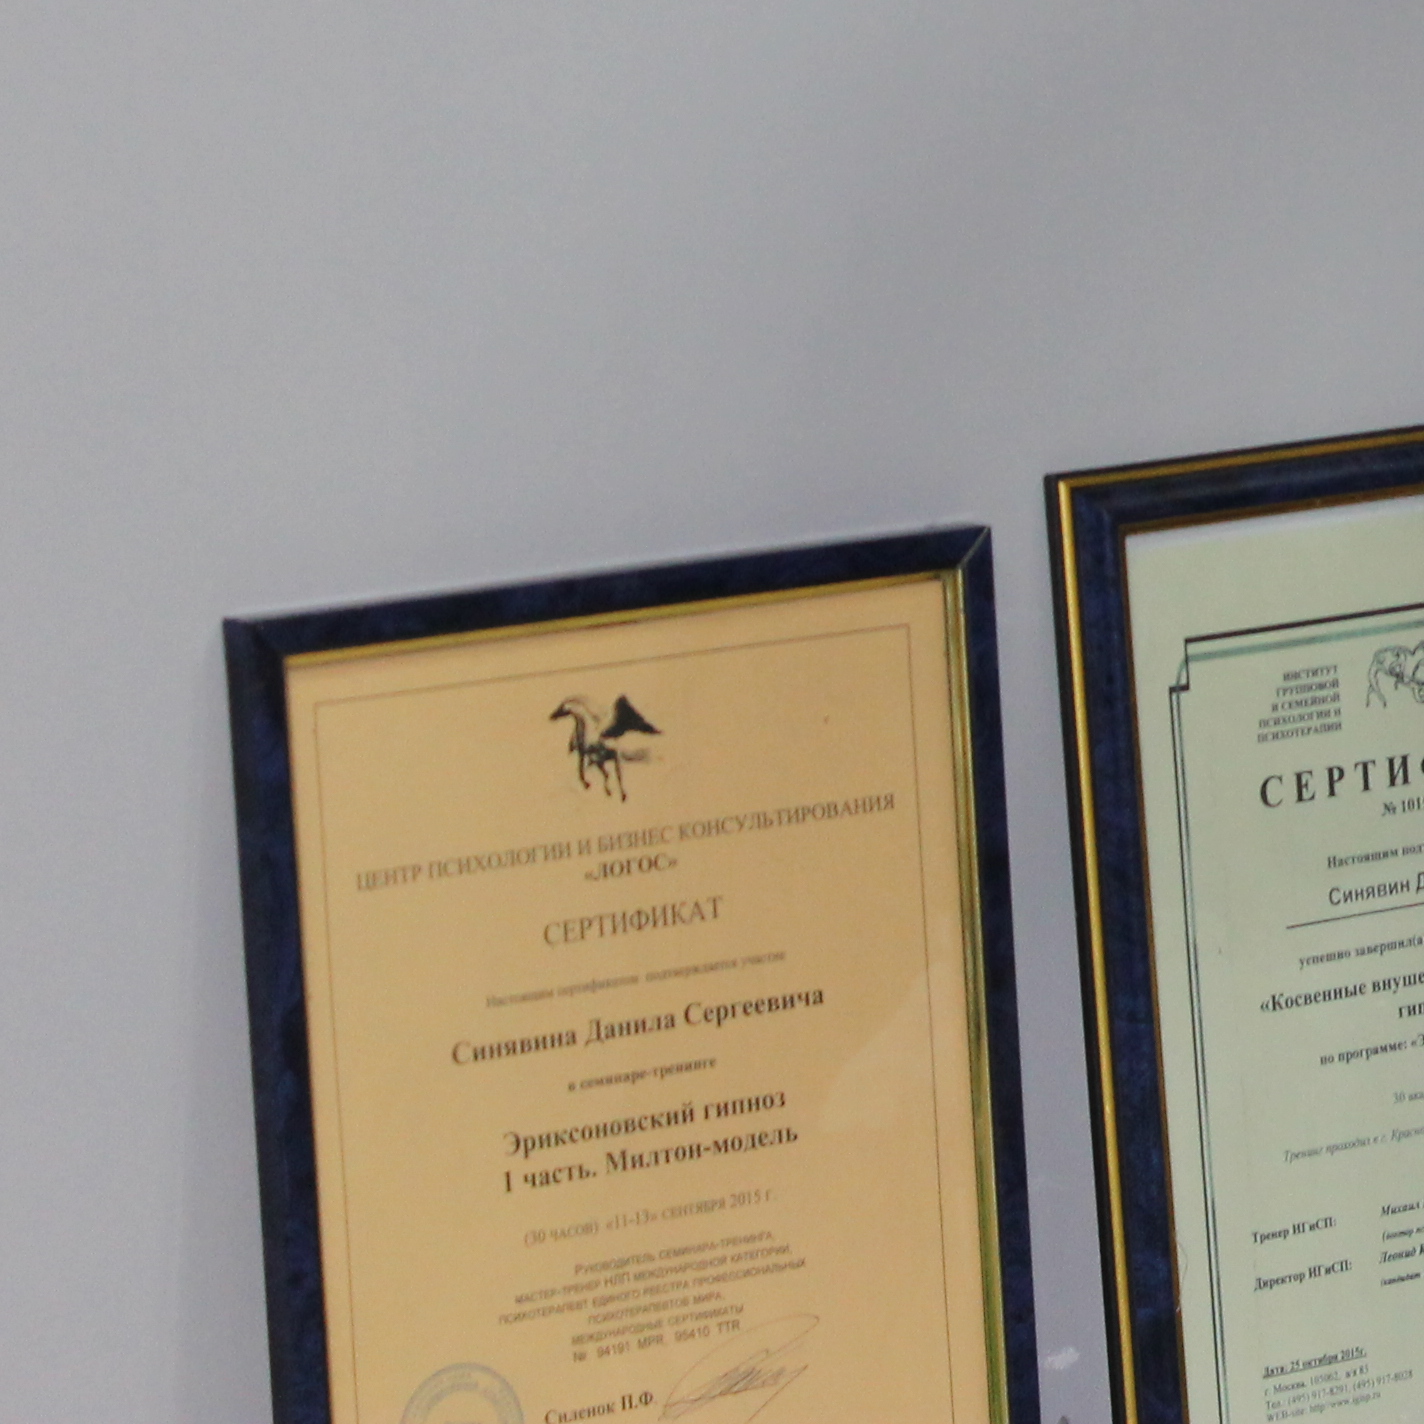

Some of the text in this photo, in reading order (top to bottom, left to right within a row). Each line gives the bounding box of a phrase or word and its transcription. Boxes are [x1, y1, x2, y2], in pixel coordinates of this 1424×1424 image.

[1380, 801, 1397, 817] №
[428, 841, 572, 880] ПСИХОЛОГИИ
[578, 838, 592, 856] И
[598, 825, 674, 854] БИЗНЕС
[679, 792, 895, 841] КОНСУЛЬТИРОВАНИЯ
[584, 852, 678, 881] «ЛОГОС»
[1327, 847, 1399, 869] Настоящим
[1328, 877, 1410, 906] Синявин
[542, 895, 724, 946] СЕРТИФИКАТ
[1299, 950, 1352, 971] успешно
[1260, 983, 1366, 1013] «Косвенные
[452, 988, 825, 1066] Синявина Данила Сергеевича
[1320, 1053, 1336, 1066] по
[1338, 1040, 1408, 1064] программе:
[503, 1091, 786, 1159] Эриксоновский гипноз
[523, 1163, 597, 1188] часть.
[606, 1126, 798, 1174] Милтон-модель
[730, 1189, 761, 1209] 2015
[1381, 1202, 1420, 1217] Михаил
[1251, 1226, 1290, 1244] Тренер
[1379, 1245, 1417, 1264] Леонид
[1254, 1270, 1306, 1292] Директор
[717, 1318, 741, 1334] TTR
